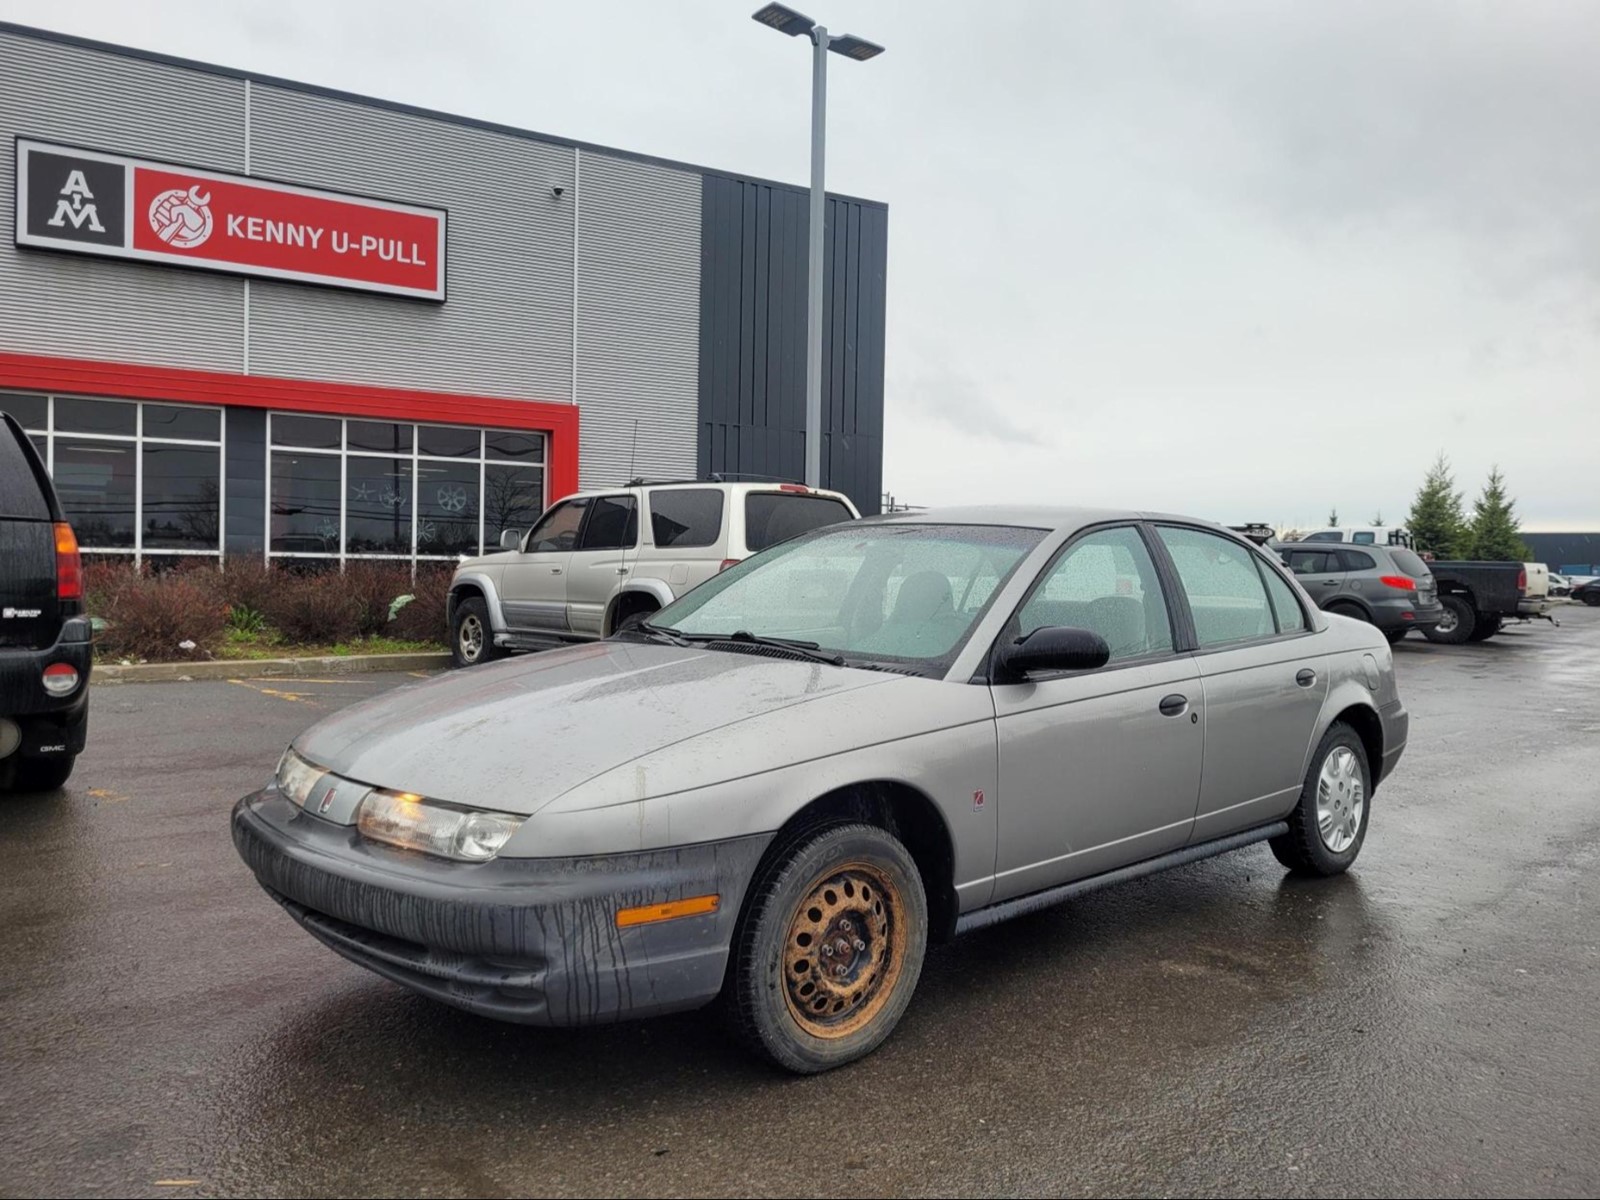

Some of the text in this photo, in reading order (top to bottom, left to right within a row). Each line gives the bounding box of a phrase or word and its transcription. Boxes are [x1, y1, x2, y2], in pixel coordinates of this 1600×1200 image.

[227, 213, 426, 266] KENNY U-PULL
[40, 744, 66, 752] GMC
